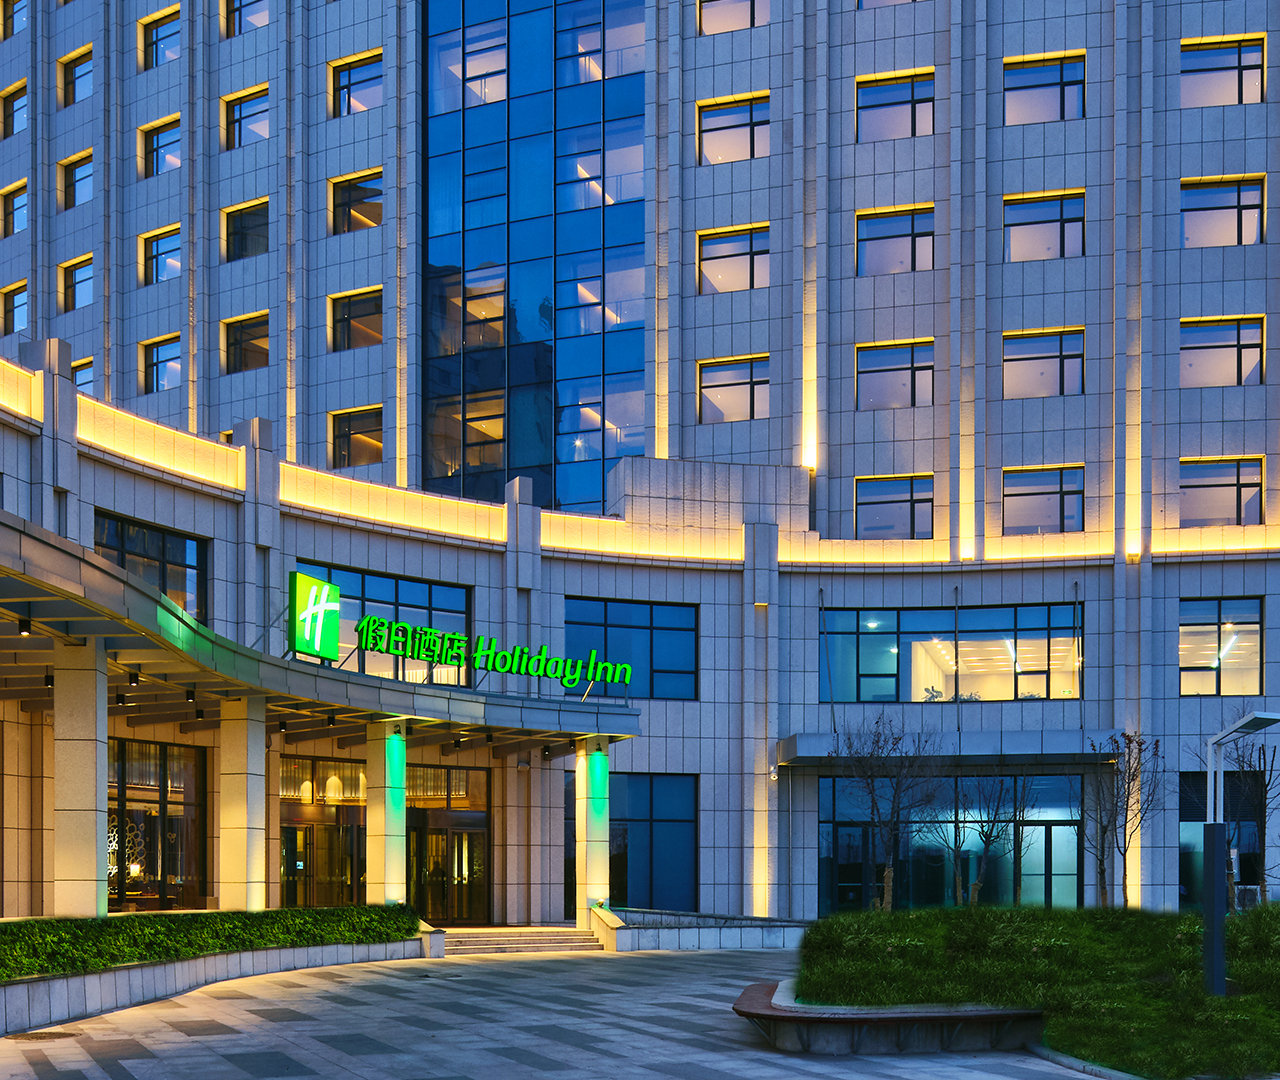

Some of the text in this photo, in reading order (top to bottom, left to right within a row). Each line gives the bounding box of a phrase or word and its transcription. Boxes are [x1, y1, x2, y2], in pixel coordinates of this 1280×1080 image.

[356, 614, 469, 668] 假日酒店
[472, 635, 632, 688] Holiday Inn
